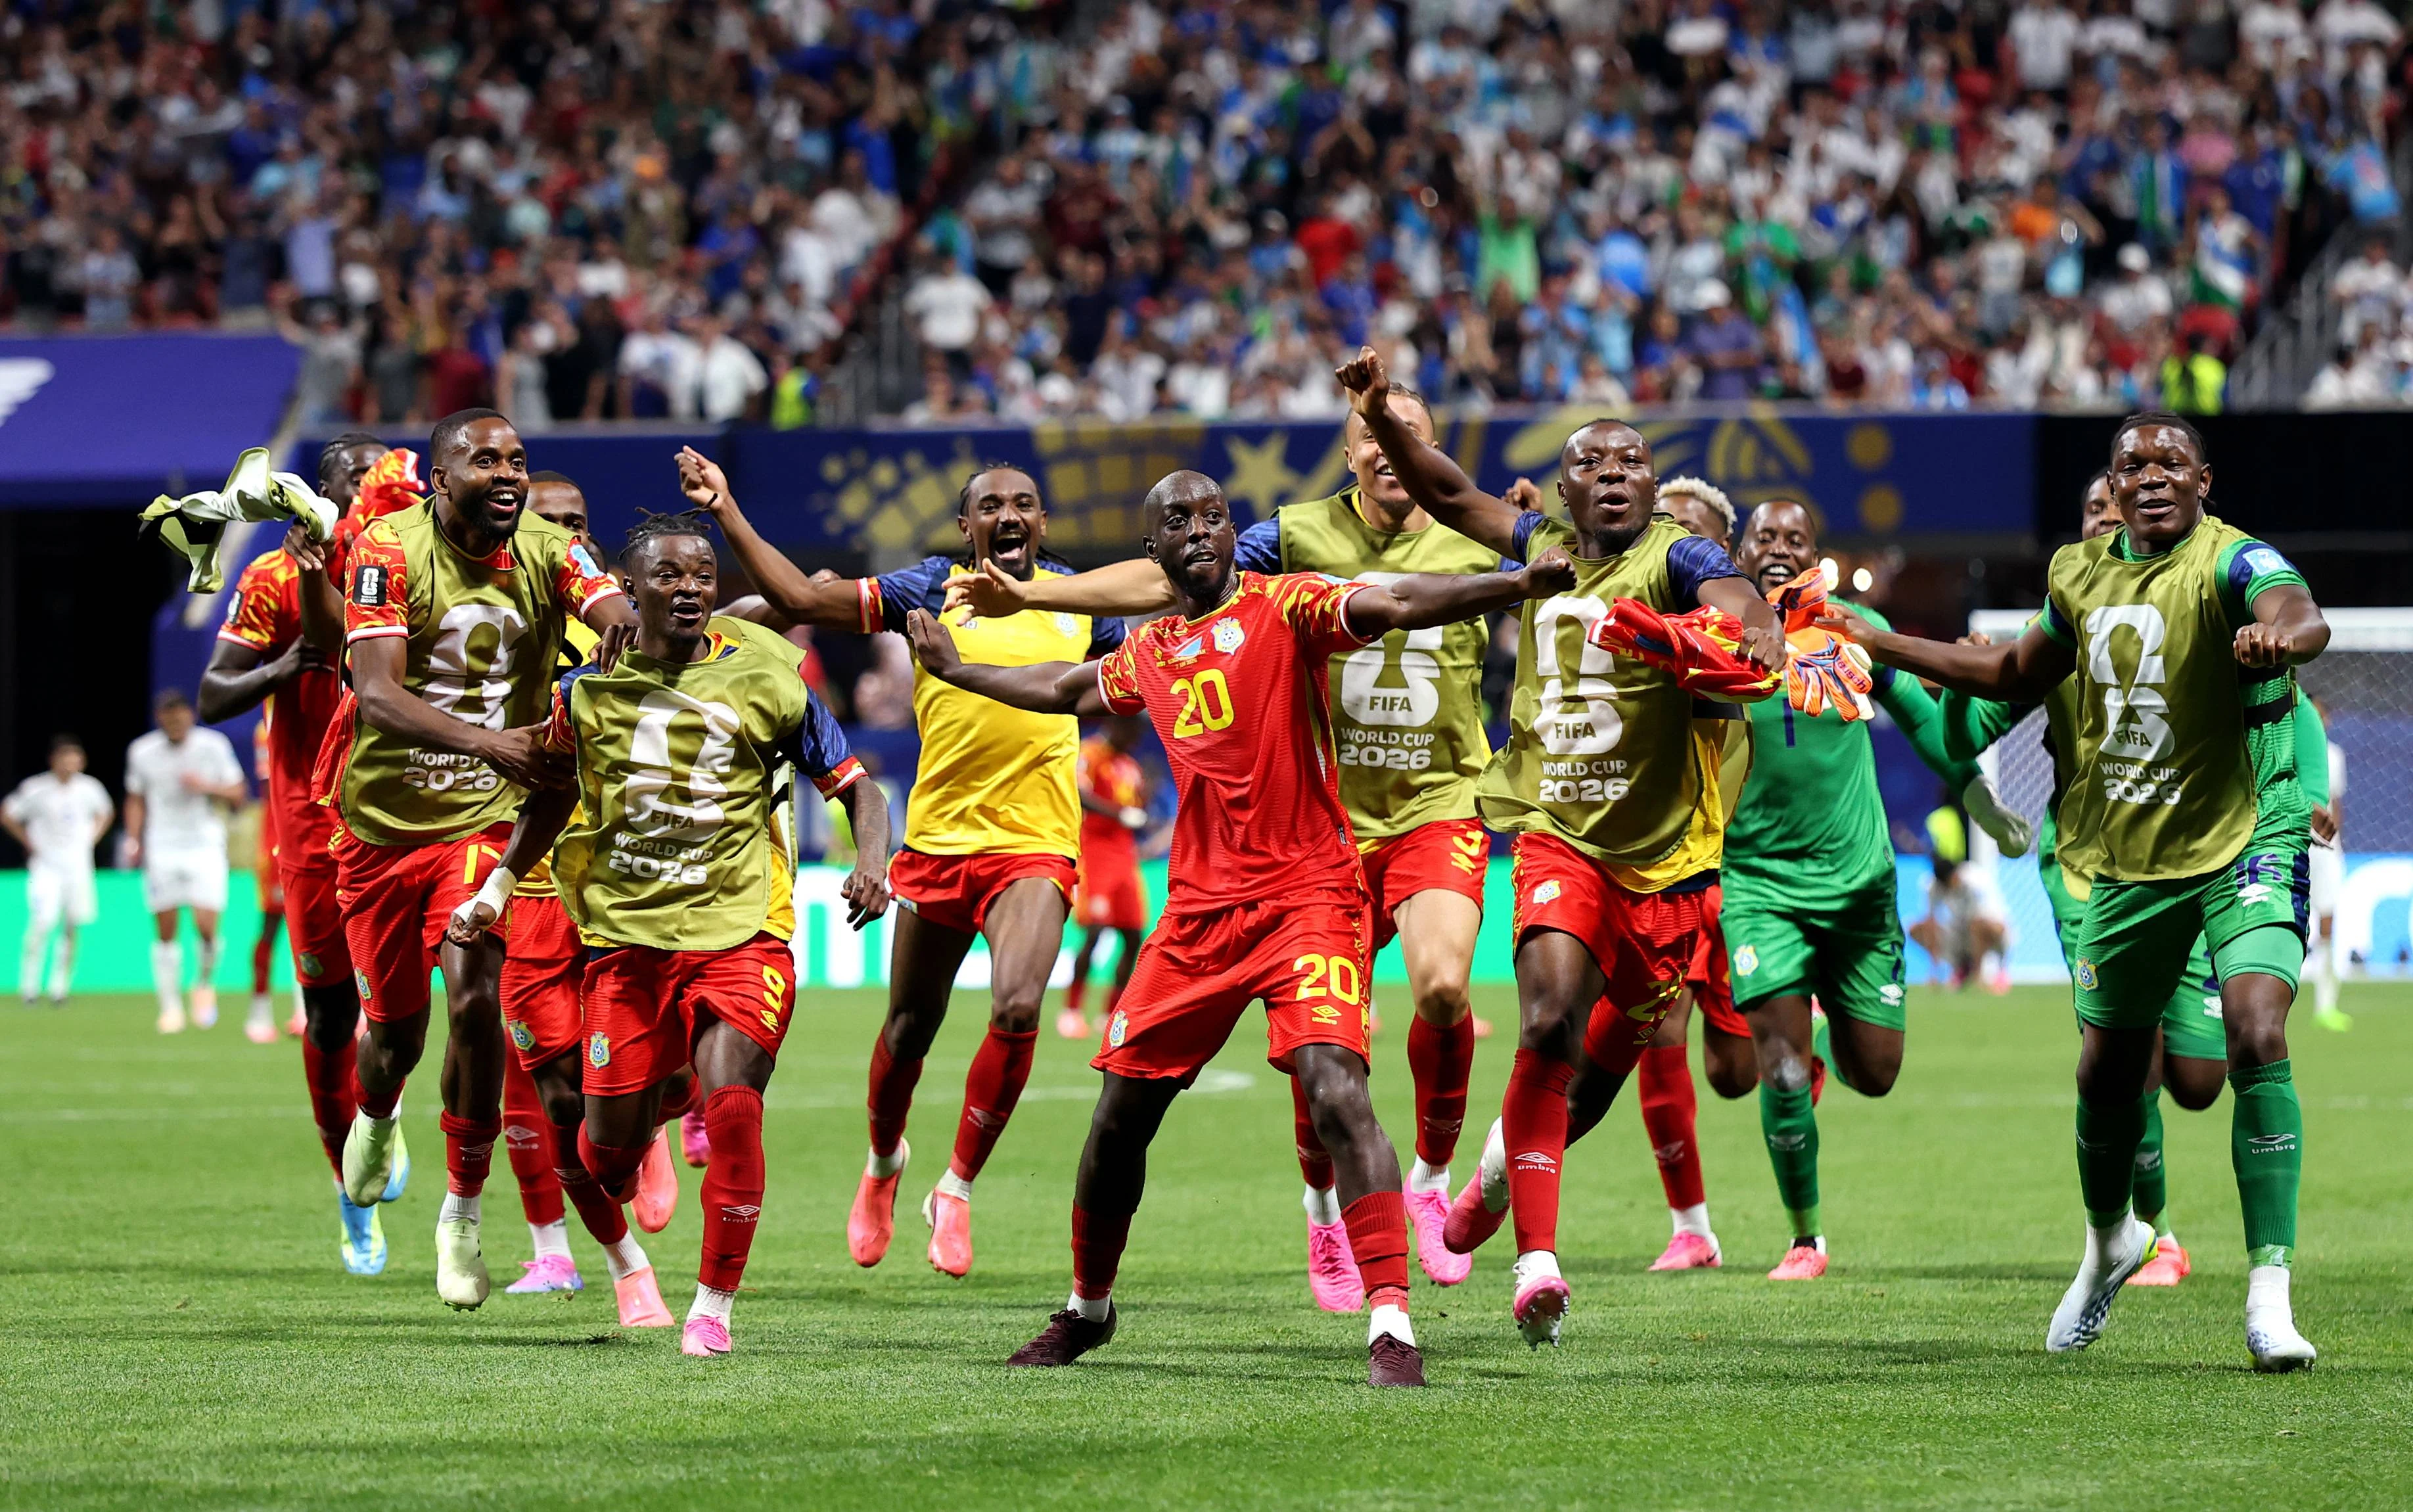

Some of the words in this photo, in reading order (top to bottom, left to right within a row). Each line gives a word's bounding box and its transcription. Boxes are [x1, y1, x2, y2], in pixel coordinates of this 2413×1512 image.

[1169, 668, 1235, 739] 20
[1369, 696, 1412, 712] FIFA
[1341, 727, 1400, 745] WORLD
[1402, 732, 1435, 747] CUP
[1555, 722, 1597, 739] FIFA
[2112, 729, 2152, 747] FIFA
[409, 748, 471, 768] WORLD
[1339, 743, 1432, 770] 2026
[1542, 760, 1588, 776] WORLD
[1591, 760, 1628, 775] CUP
[2099, 762, 2147, 779] WORLD
[2149, 767, 2182, 781] CUP
[402, 766, 497, 791] 2026
[1539, 777, 1630, 803] 2026
[2103, 778, 2182, 806] 2026
[651, 809, 695, 829] FIFA
[614, 831, 677, 857] WORLD
[679, 846, 714, 862] CUP
[609, 849, 708, 885] 2026
[1293, 953, 1360, 1005] 20
[2251, 1144, 2295, 1154] umbro
[1517, 1163, 1556, 1174] umbro
